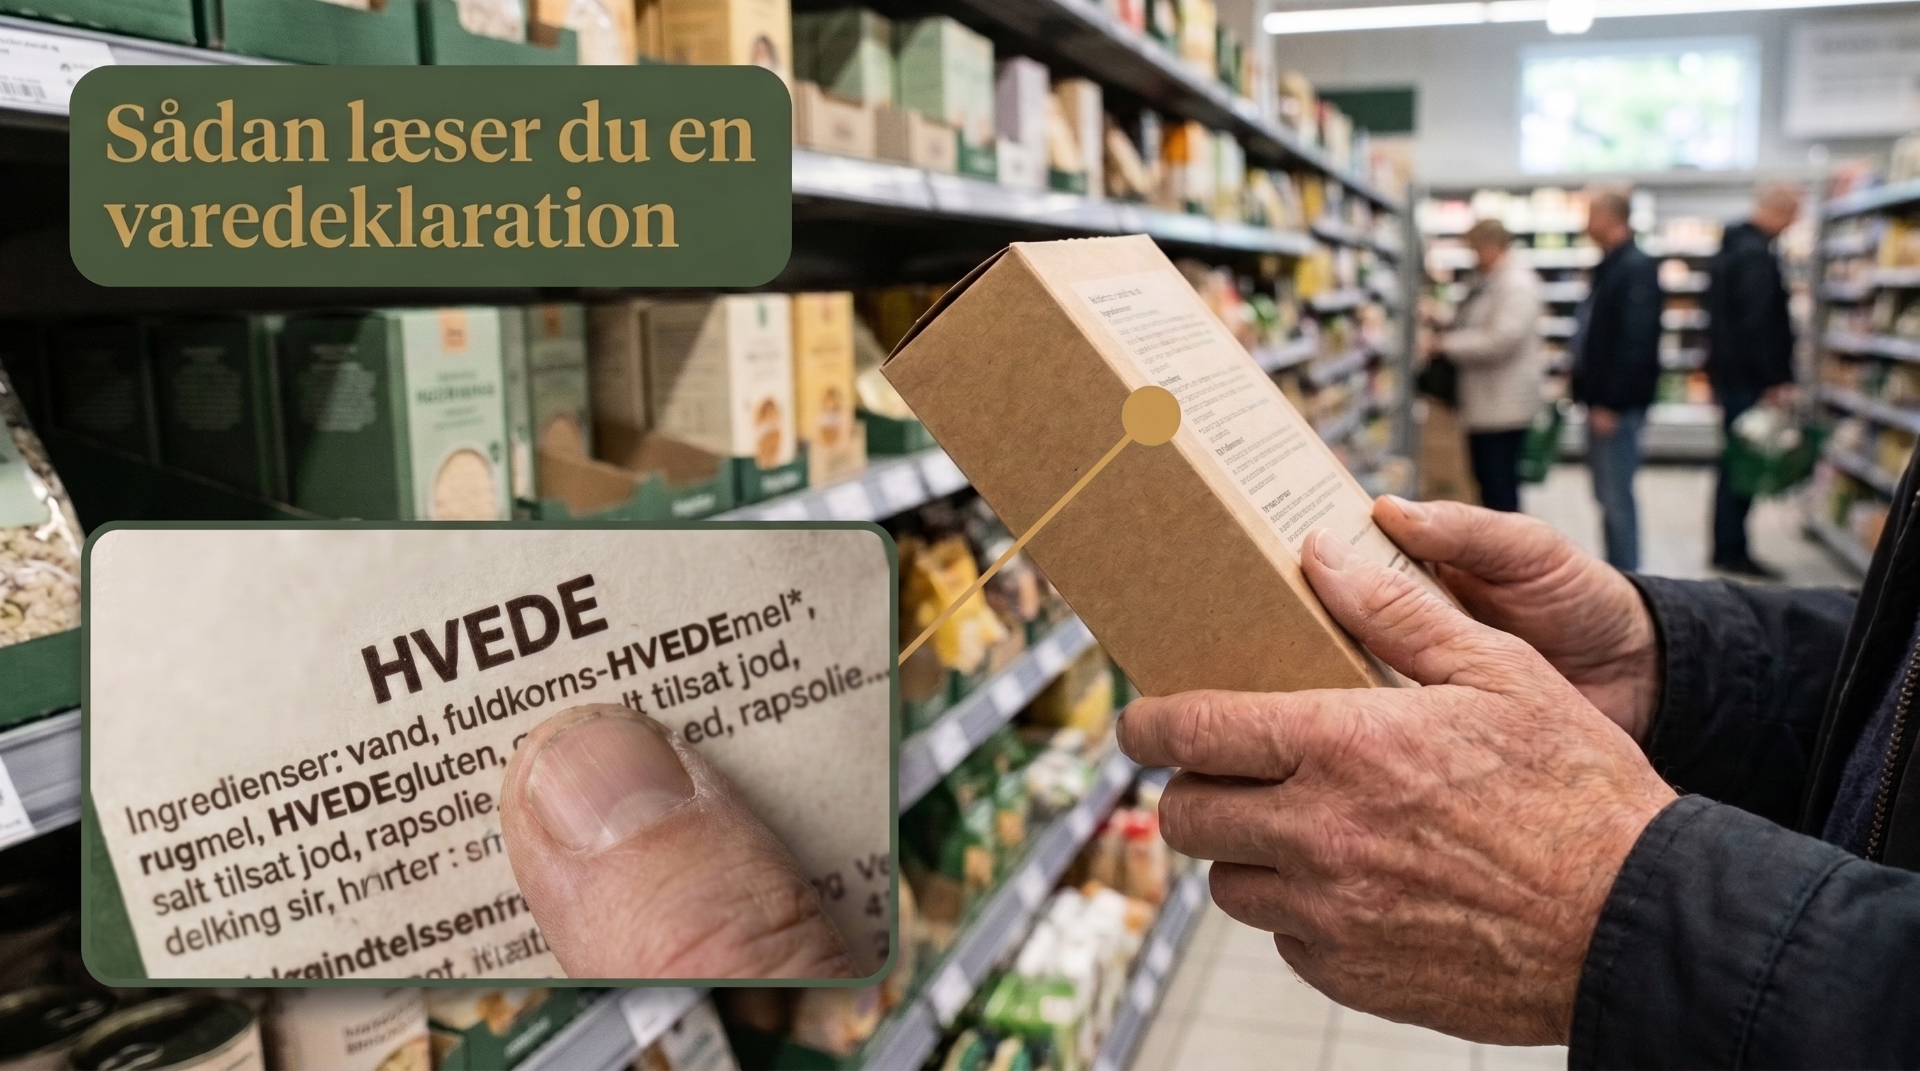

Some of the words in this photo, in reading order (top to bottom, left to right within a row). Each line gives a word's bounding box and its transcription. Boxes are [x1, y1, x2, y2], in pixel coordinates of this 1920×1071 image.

[360, 573, 609, 704] HVEDE
[125, 749, 343, 835] Ingredienser:
[345, 714, 440, 766] vand,
[138, 815, 266, 876] rugmel,
[267, 745, 507, 837] HVEDEgluten,
[651, 660, 734, 711] tilsat
[737, 639, 801, 690] jod,
[152, 877, 211, 917] salt
[213, 851, 296, 899] tilsat
[296, 831, 362, 882] jod,
[165, 909, 282, 957] delking
[287, 888, 335, 922] sir,
